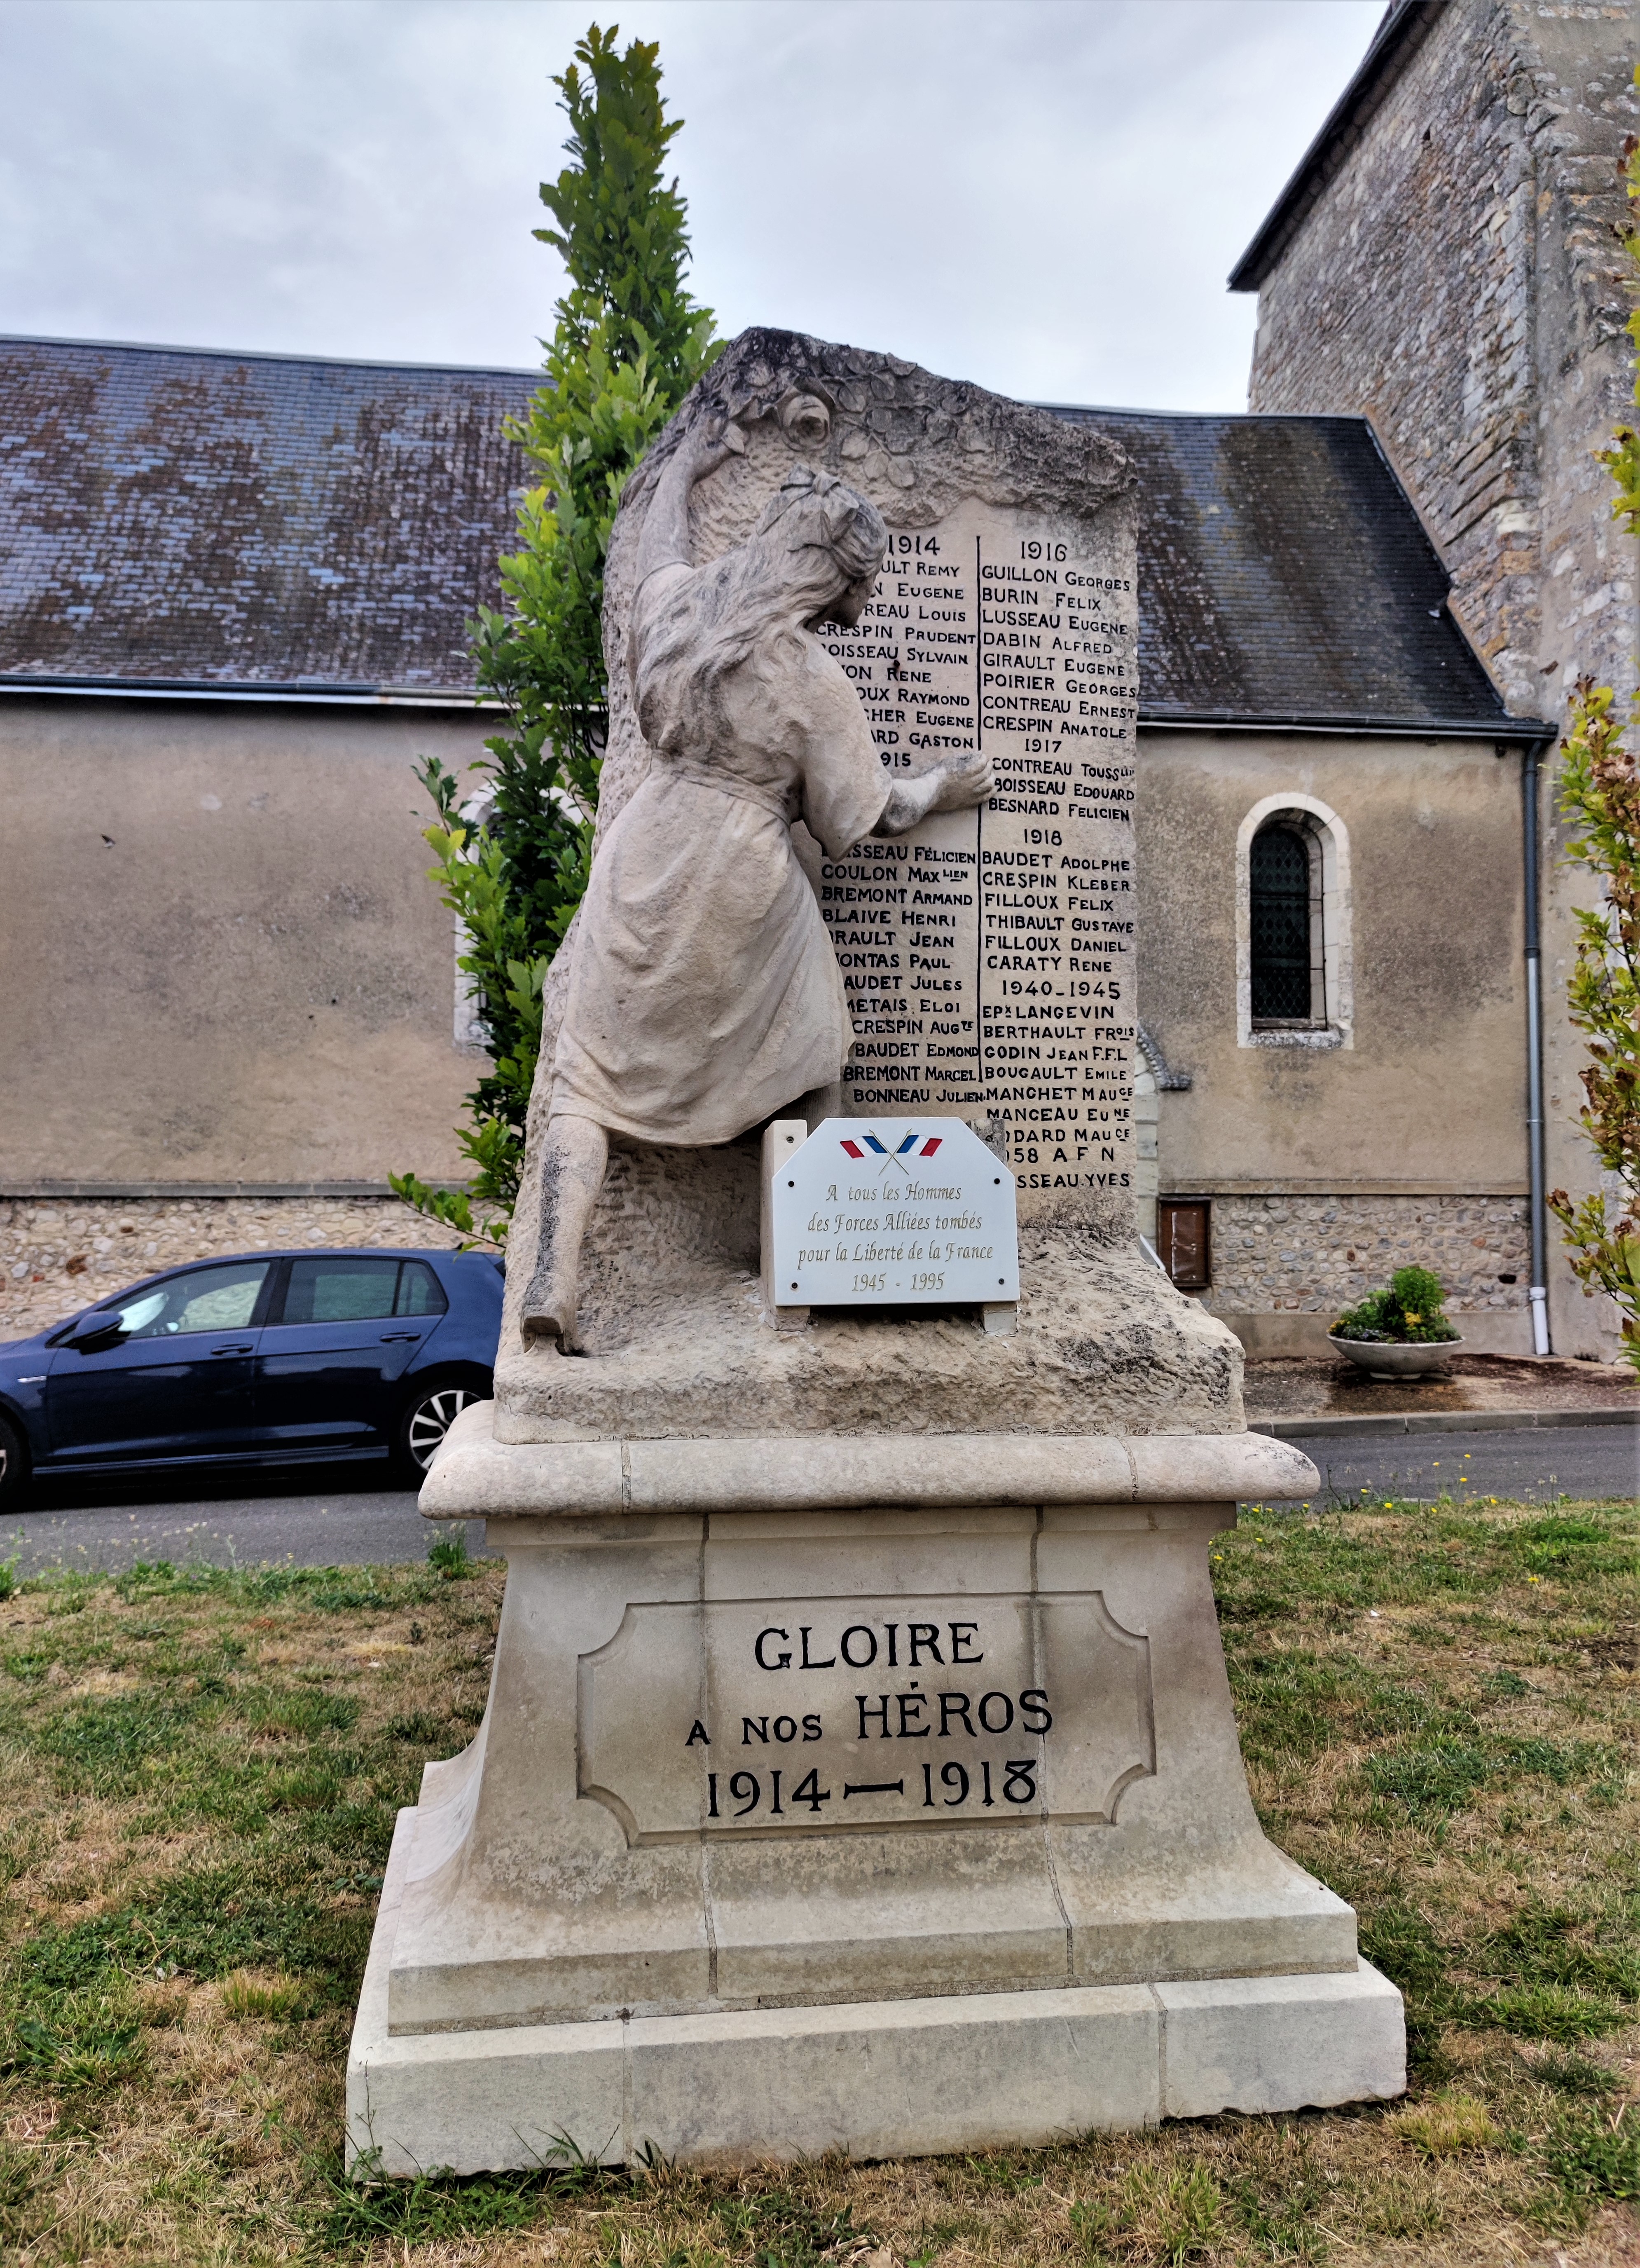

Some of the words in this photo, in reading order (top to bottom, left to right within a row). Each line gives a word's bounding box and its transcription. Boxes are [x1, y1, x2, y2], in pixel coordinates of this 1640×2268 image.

[889, 534, 940, 556] 1914
[1021, 541, 1067, 562] 1916
[881, 560, 910, 574] ULT
[917, 562, 959, 577] REMY
[982, 565, 1057, 584] GUILLON
[1065, 572, 1130, 591] GEORGES
[898, 583, 964, 600] EUGENE
[982, 587, 1038, 605] BURIN
[1056, 593, 1101, 611] FELIX
[865, 604, 909, 619] REAU
[919, 606, 966, 622] LOUIS
[983, 609, 1060, 629] LUSSEAU
[1069, 616, 1127, 635] EUGENE
[815, 623, 892, 639] CRESPIN
[905, 627, 976, 644] PRUDENT
[983, 632, 1041, 649] DABIN
[1052, 637, 1112, 654] ALFRED
[821, 643, 898, 659] OISSEAU
[907, 647, 969, 665] SYLVAIN
[983, 653, 1055, 670] GIRAULT
[1064, 658, 1125, 676] EUGENE
[887, 667, 931, 683] RENE
[984, 673, 1055, 691] POIRIER
[898, 688, 970, 706] RAYMOND
[983, 696, 1071, 713] CONTREAU
[1079, 701, 1135, 719] ERNEST
[916, 711, 974, 729] EUGENE
[983, 715, 1052, 733] CRESPIN
[1060, 721, 1127, 739] ANATOLE
[909, 733, 973, 749] GASTON
[1025, 738, 1062, 753] 1917
[880, 752, 911, 768] 915
[992, 757, 1072, 776] CONTREAU
[994, 778, 1066, 795] BOISSEAU
[1074, 783, 1135, 801] EDOUARD
[988, 797, 1059, 815] BESNARD
[1069, 804, 1130, 823] FELICIEN
[1024, 829, 1062, 846] 1918
[821, 843, 908, 862] SSEAU
[914, 846, 976, 864] FÉLICIEN
[982, 851, 1053, 868] BAUDET
[1060, 856, 1130, 873] ADOLPHE
[821, 863, 898, 881] COULON
[983, 872, 1056, 888] CRESPIN
[1068, 875, 1130, 892] KLEBER
[821, 885, 908, 904] BREMONT
[912, 890, 973, 905] ARMAND
[985, 893, 1059, 910] FILLOUX
[1068, 897, 1114, 911] FELIX
[822, 908, 891, 924] BLAIVE
[901, 910, 955, 927] HENRI
[986, 914, 1064, 931] THIBAULT
[1071, 918, 1134, 934] GUSTAVE
[909, 931, 954, 948] JEAN
[985, 935, 1061, 952] FILLOUX
[1071, 938, 1127, 953] DANIEL
[835, 952, 900, 968] ONTAS
[910, 954, 950, 971] PAUL
[987, 955, 1062, 971] CARATY
[1069, 957, 1112, 972] RENE
[844, 975, 903, 990] AUDET
[910, 975, 962, 991] JULES
[920, 999, 959, 1013] ELOI
[1016, 1005, 1114, 1019] LANGEVIN
[852, 1018, 923, 1035] CRESPIN
[983, 1025, 1086, 1039] BERTHAULT
[854, 1042, 919, 1058] BAUDET
[926, 1043, 979, 1058] EDMOND
[984, 1046, 1040, 1060] GODIN
[1046, 1047, 1088, 1061] JEAN
[842, 1065, 921, 1082] BREMONT
[924, 1066, 977, 1082] MARCEL
[985, 1066, 1078, 1080] BOUGAULT
[1085, 1067, 1126, 1080] EMILE
[853, 1088, 930, 1104] BONNEAU
[986, 1087, 1077, 1101] MANCHET
[987, 1107, 1078, 1122] MANCEAU
[1005, 1129, 1065, 1143] DARD
[1006, 1148, 1039, 1164] 58
[1053, 1148, 1068, 1162] A
[1077, 1146, 1088, 1161] F
[1102, 1147, 1114, 1162] N
[1084, 1173, 1130, 1187] YVES
[826, 1184, 838, 1202] A
[849, 1186, 877, 1201] tous
[883, 1181, 900, 1200] les
[905, 1181, 962, 1200] Hommes
[808, 1212, 830, 1231] des
[834, 1214, 879, 1234] Forces
[883, 1211, 930, 1231] Alliées
[936, 1210, 982, 1230] tombés
[798, 1248, 830, 1270] pour
[835, 1242, 848, 1261] la
[852, 1241, 903, 1261] Liberté
[908, 1240, 923, 1260] de
[929, 1240, 940, 1260] la
[945, 1242, 993, 1263] France
[852, 1272, 887, 1291] 1945
[910, 1272, 945, 1291] 1995
[755, 1622, 984, 1671] GLOIRE
[684, 1719, 712, 1746] A
[741, 1714, 822, 1746] NOS
[854, 1681, 1053, 1740] HÉROS
